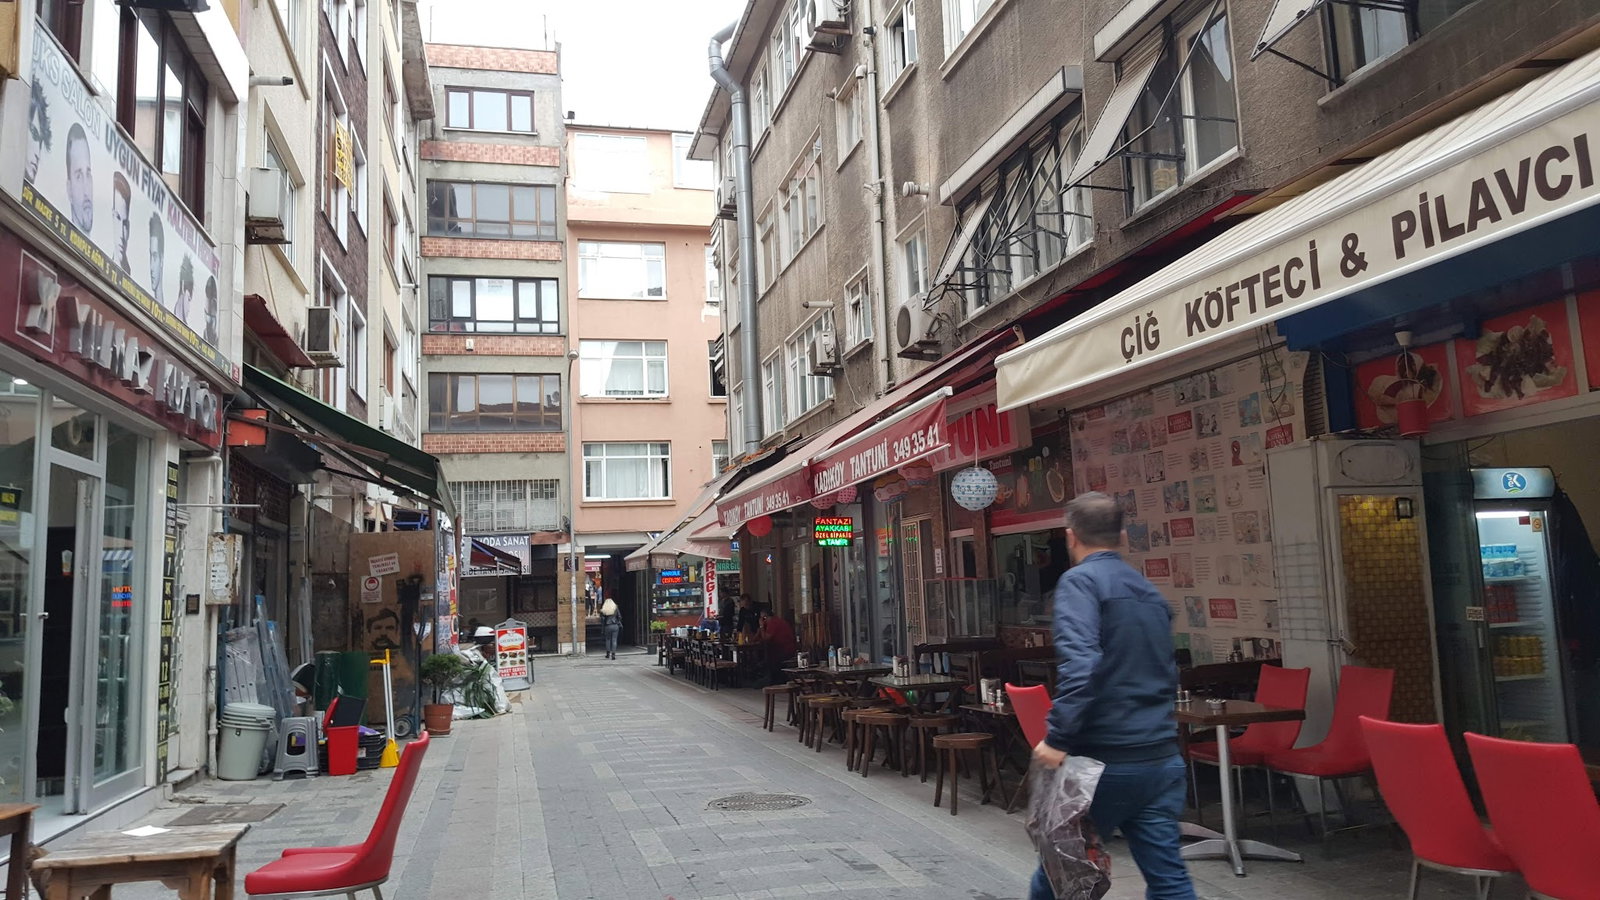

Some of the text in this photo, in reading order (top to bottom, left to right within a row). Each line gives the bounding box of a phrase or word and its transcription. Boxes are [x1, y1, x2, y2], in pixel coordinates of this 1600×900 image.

[61, 69, 101, 140] SALON
[105, 125, 141, 190] UYGUN
[1120, 133, 1595, 363] ÇİĞ KÖFTECİ & PİLAVCI
[69, 296, 156, 396] YILMAZ
[814, 422, 940, 495] KADIKÖY TANTUNİ 349 35 41
[504, 536, 529, 546] SANAT
